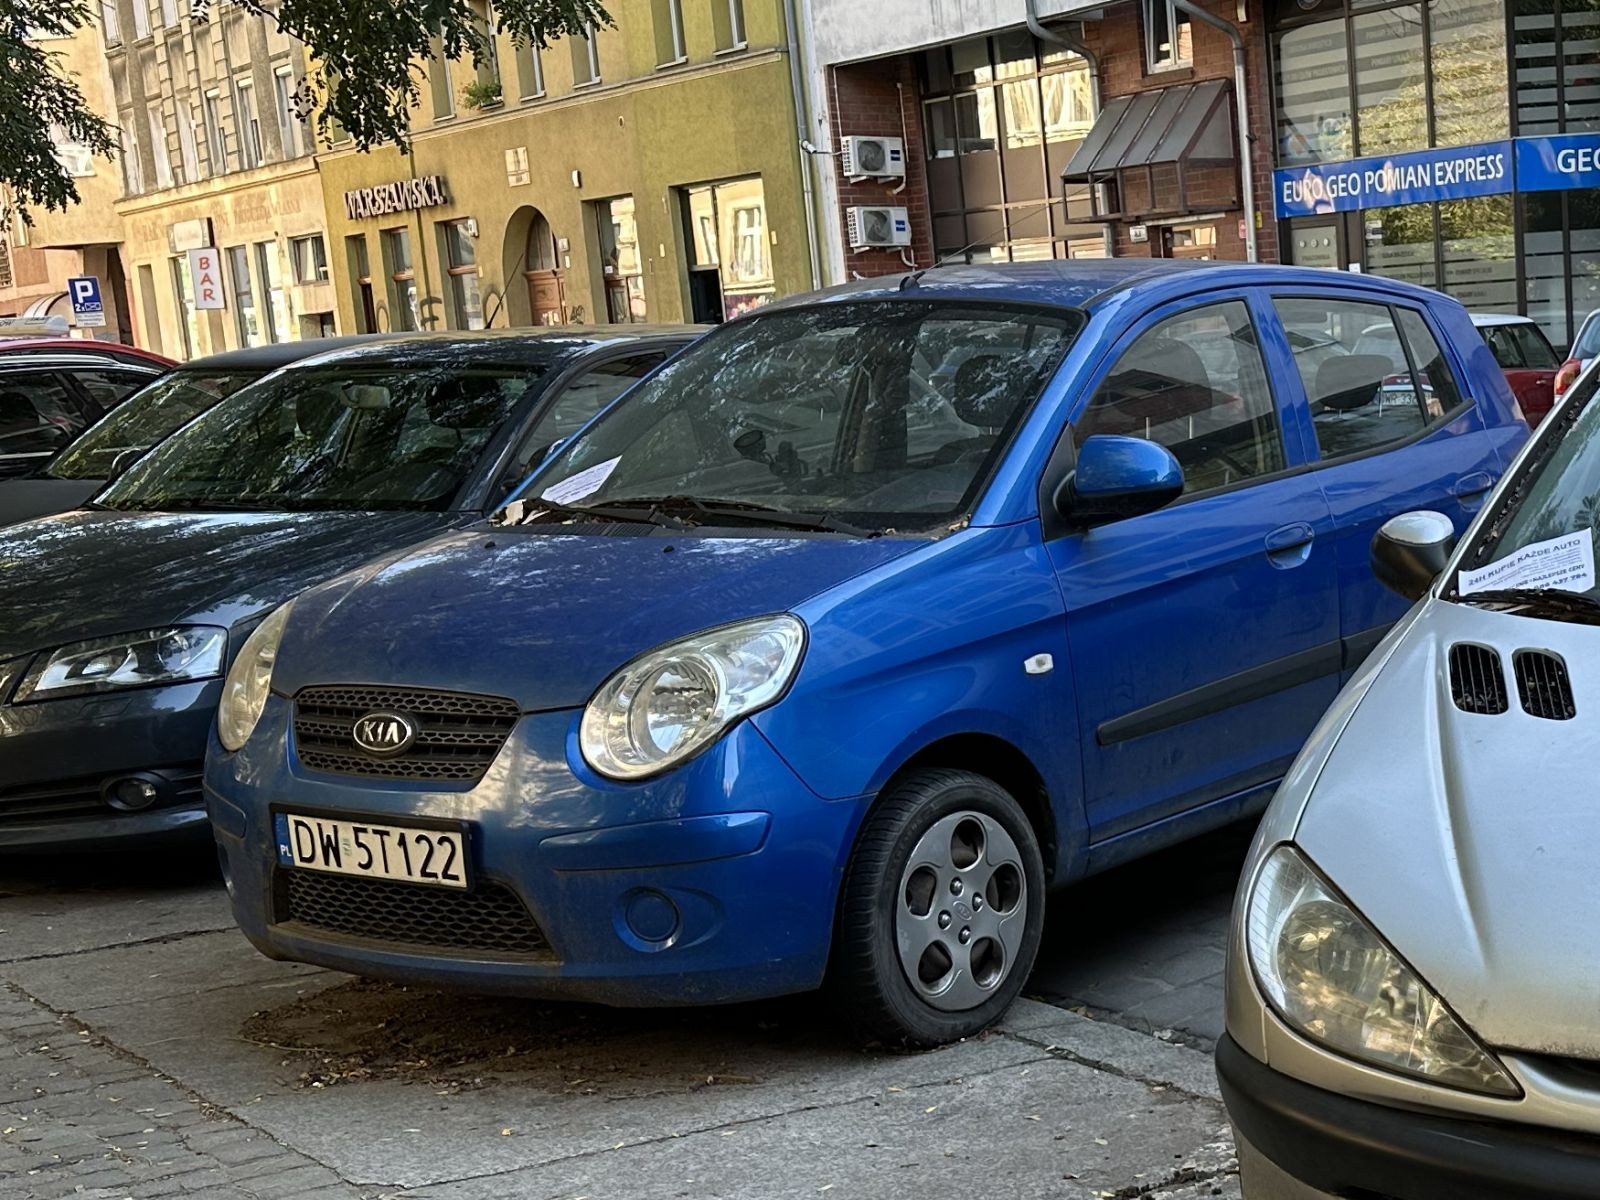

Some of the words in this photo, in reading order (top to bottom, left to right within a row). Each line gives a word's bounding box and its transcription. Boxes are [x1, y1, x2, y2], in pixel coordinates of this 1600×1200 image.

[1283, 177, 1325, 203] EURO
[1327, 172, 1361, 198] GEO
[1365, 163, 1430, 193] POMIAN
[1435, 153, 1504, 186] EXPRESS
[75, 281, 93, 303] P
[199, 257, 216, 301] BAR
[1468, 575, 1486, 587] 24H
[1553, 539, 1581, 552] AUTO
[363, 721, 399, 743] KIA
[280, 844, 292, 857] PL
[294, 820, 342, 868] DW
[352, 826, 460, 881] 5T122
